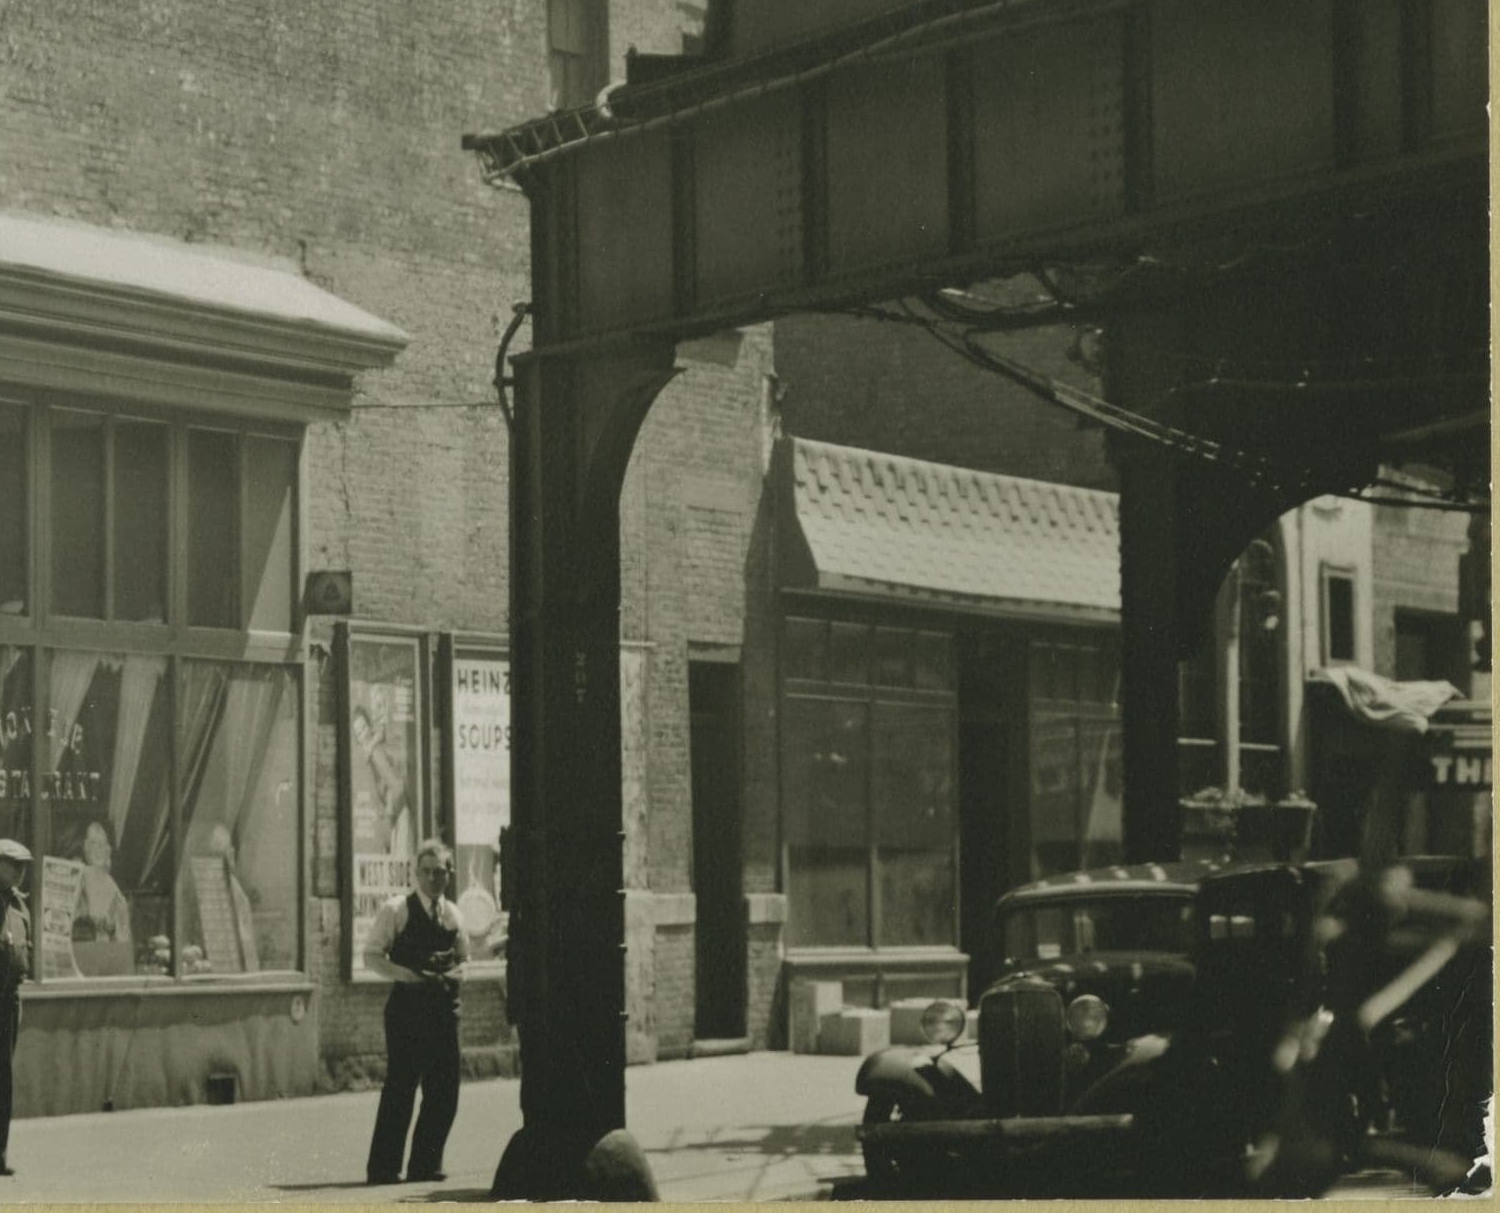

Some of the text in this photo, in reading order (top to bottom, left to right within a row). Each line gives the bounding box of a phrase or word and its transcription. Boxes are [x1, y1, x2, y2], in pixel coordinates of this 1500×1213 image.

[457, 668, 511, 695] HEINZ
[458, 723, 511, 751] SOUPS
[359, 860, 411, 888] WEST SIDE
